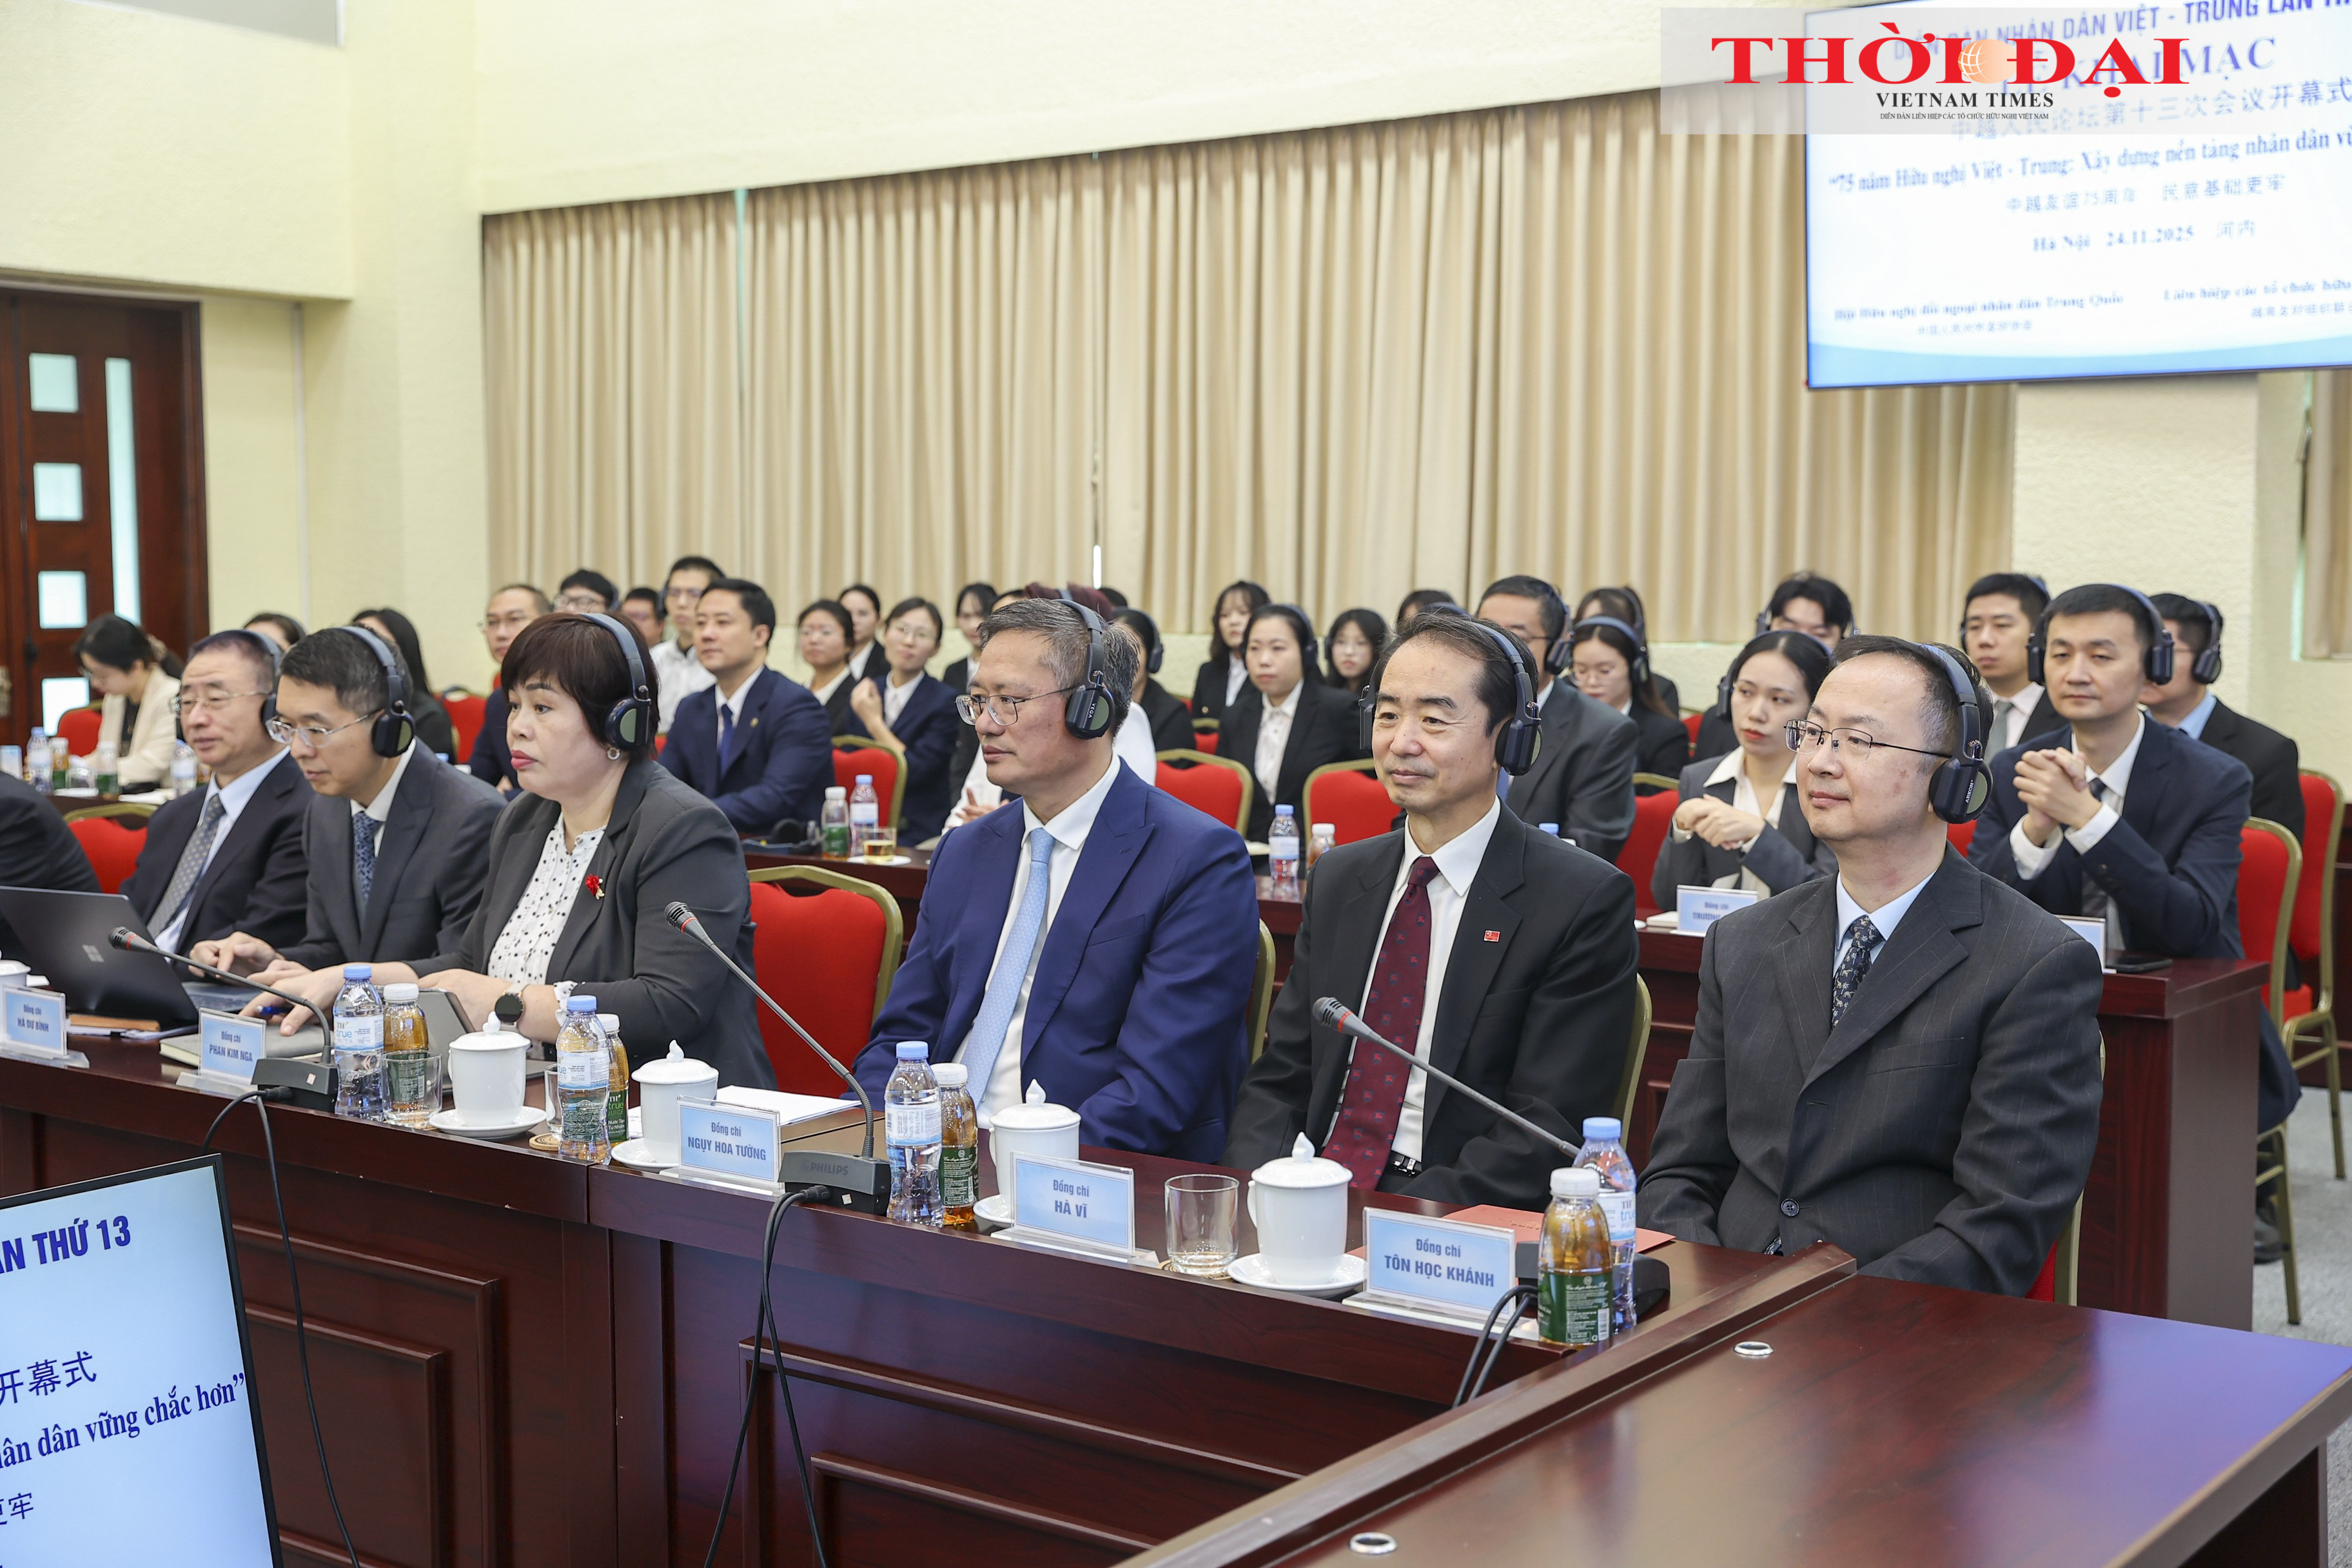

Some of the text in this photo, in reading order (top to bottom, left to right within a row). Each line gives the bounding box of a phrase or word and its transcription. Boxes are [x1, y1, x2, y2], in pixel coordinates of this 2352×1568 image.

[2185, 0, 2259, 24] TRUNG
[2296, 127, 2330, 151] dân
[1088, 703, 1096, 718] VEGA
[210, 1044, 253, 1062] PHAN KIM NGA
[711, 1122, 741, 1137] Đồng chí
[688, 1137, 766, 1161] NGỤY HOA TƯỜNG
[810, 1162, 848, 1175] PHILIPS
[1053, 1179, 1089, 1197] Đồng chí
[1055, 1199, 1088, 1218] HÀ VĨ
[0, 1215, 131, 1274] N THỨ 13
[1416, 1238, 1462, 1257] Đồng chí
[1384, 1254, 1494, 1287] TÔN HỌC KHÁNH
[0, 1351, 97, 1406] 开幕式
[0, 1373, 246, 1469] ân dân vững chắc hơn”
[0, 1492, 34, 1526] 牢
